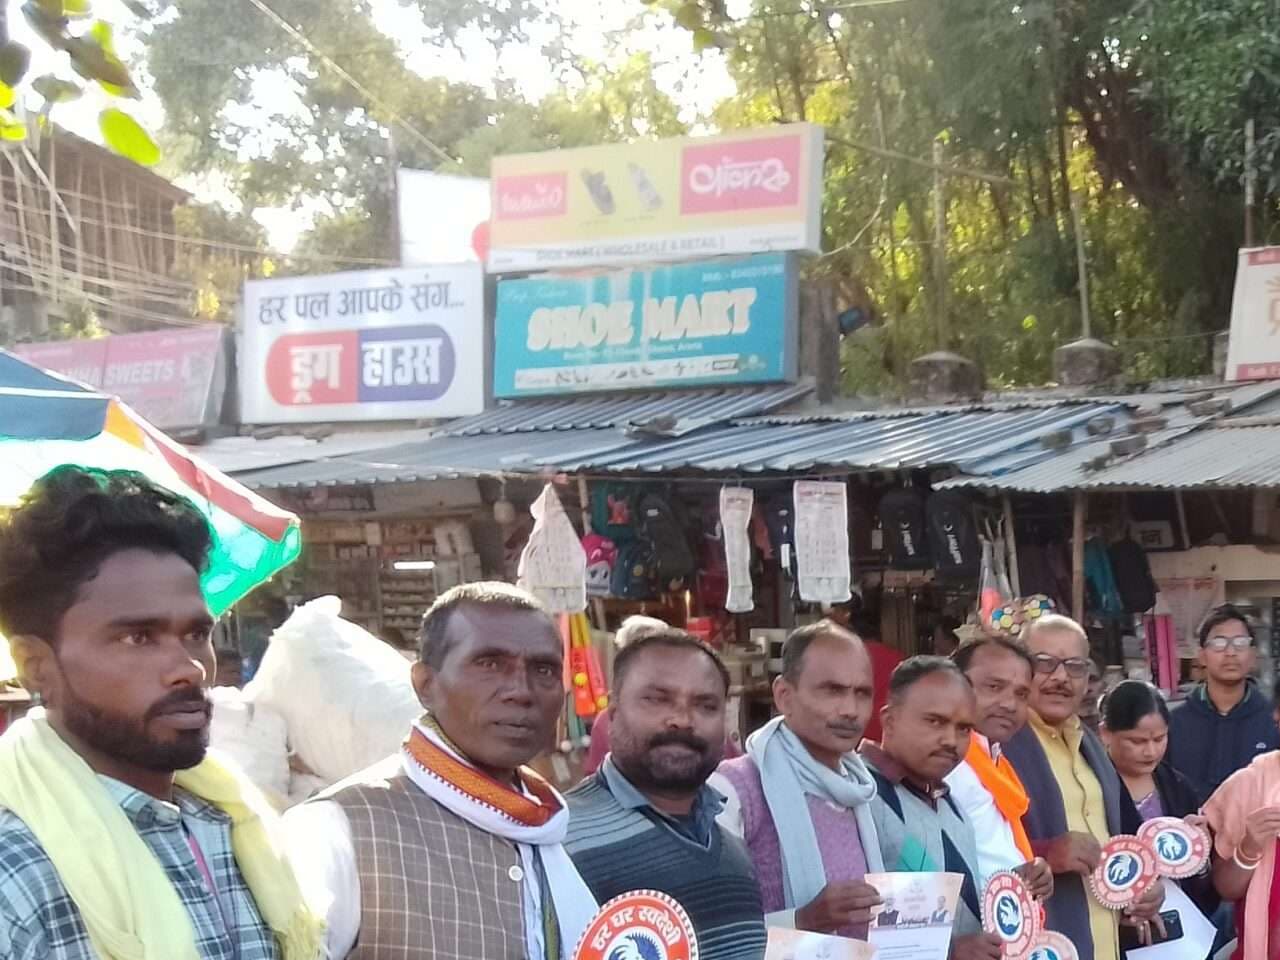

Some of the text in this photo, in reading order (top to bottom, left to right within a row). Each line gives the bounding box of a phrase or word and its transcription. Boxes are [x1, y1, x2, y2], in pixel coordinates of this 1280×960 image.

[258, 295, 289, 325] हर
[295, 290, 330, 320] पल
[337, 278, 404, 317] आपके
[527, 287, 757, 351] SHOE MART
[106, 359, 176, 386] SWEETS
[361, 337, 444, 387] हाउस
[637, 904, 681, 947] स्वदेशी
